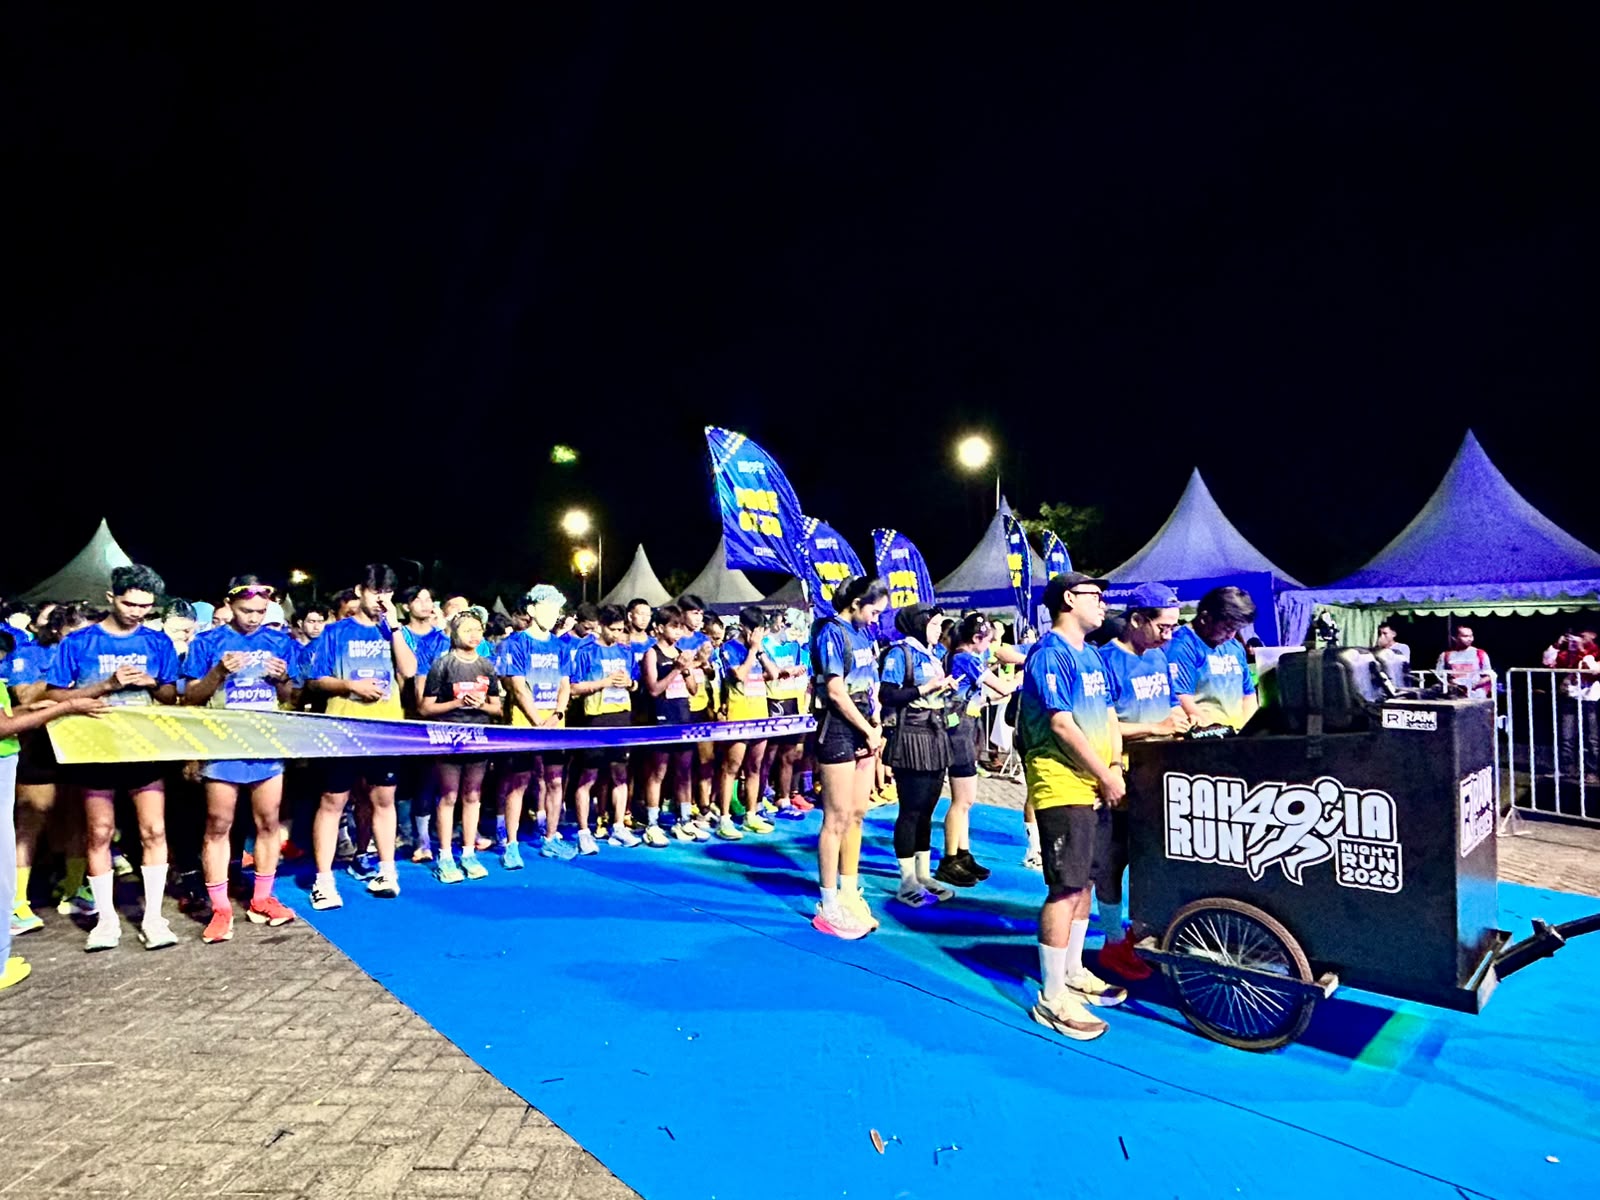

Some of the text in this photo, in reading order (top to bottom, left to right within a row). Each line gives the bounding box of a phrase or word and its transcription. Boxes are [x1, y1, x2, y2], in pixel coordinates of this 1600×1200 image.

[1169, 818, 1246, 864] RUN
[1340, 842, 1395, 858] NIGHT
[1341, 852, 1396, 873] RUN
[1342, 866, 1396, 888] 2026
